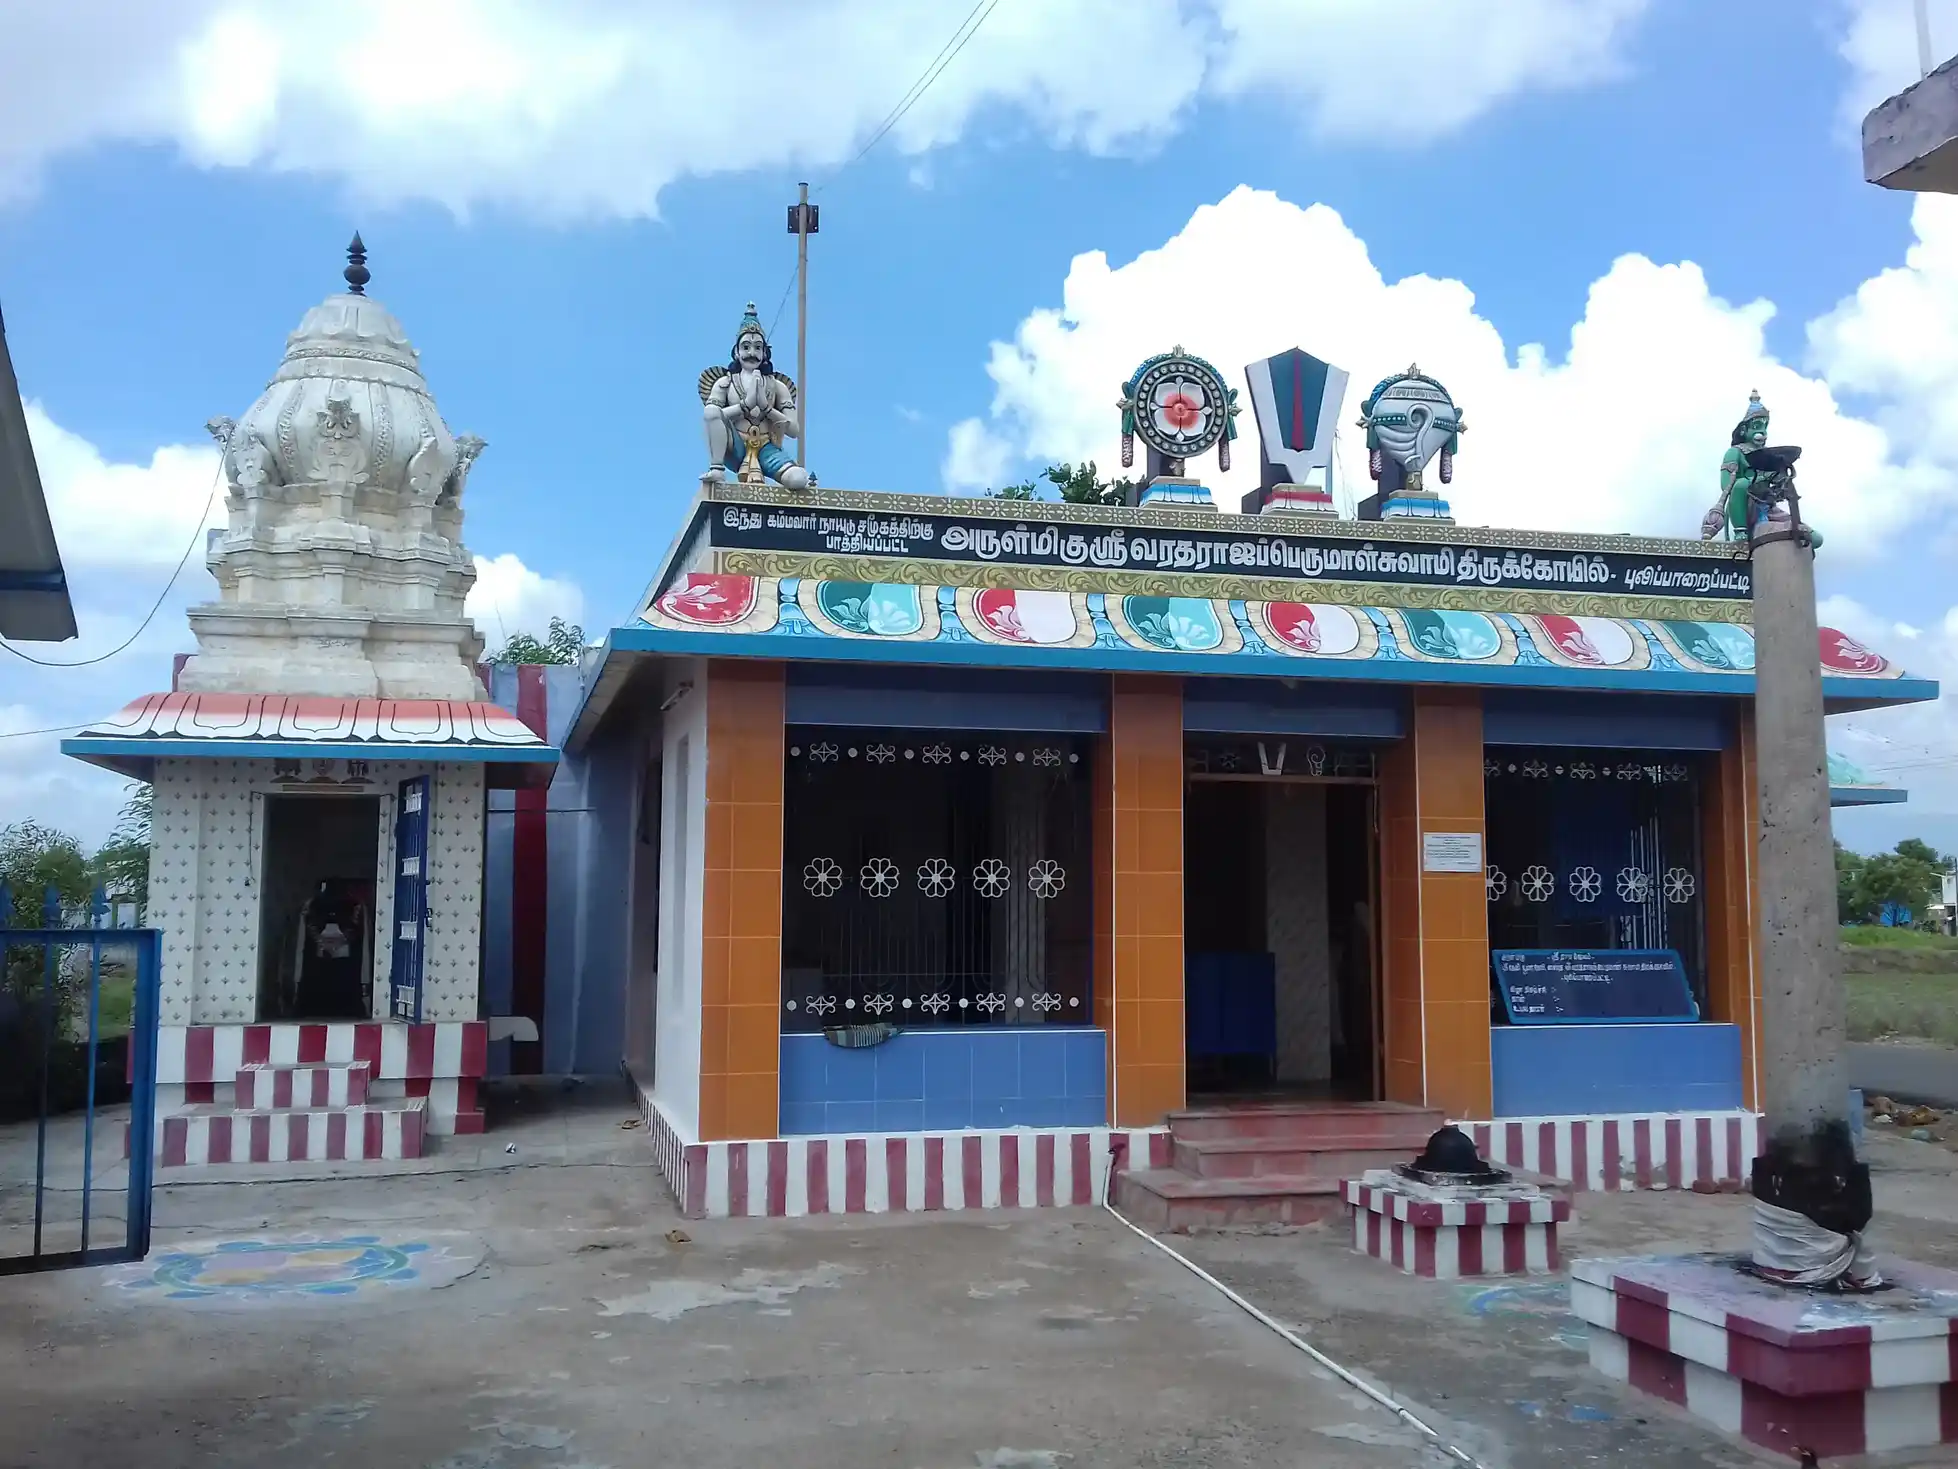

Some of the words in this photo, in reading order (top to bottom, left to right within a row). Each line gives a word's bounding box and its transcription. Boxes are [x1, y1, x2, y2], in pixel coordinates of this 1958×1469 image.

[767, 510, 817, 531] கம்மவார்
[818, 516, 855, 536] நாயுடு
[826, 533, 909, 553] பாத்தியப்பட்ட
